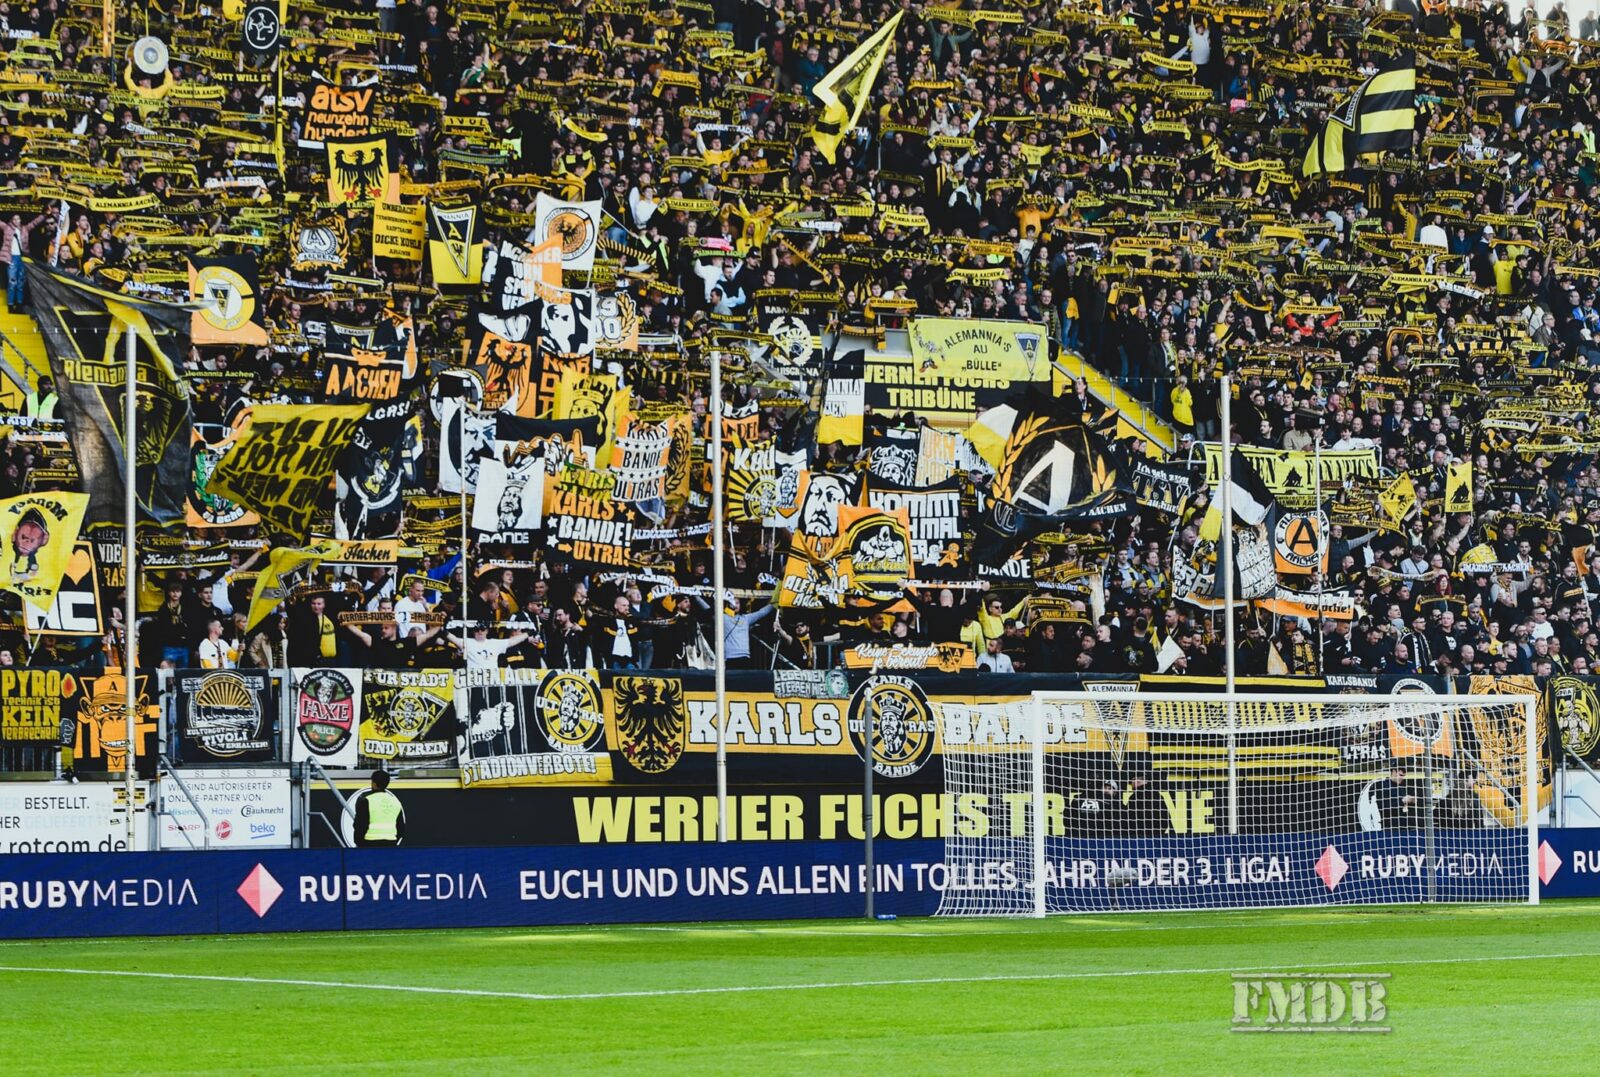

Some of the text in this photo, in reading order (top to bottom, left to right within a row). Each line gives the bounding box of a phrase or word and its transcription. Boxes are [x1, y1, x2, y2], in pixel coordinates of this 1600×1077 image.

[236, 73, 259, 82] WILL
[311, 85, 373, 112] atsv
[308, 110, 369, 126] neunzehn
[1069, 105, 1112, 118] ALEMANNIA
[304, 122, 369, 141] hundert
[1129, 188, 1169, 197] ALEMANNIA
[95, 201, 133, 209] ALEMANNIA
[448, 222, 462, 239] A
[980, 270, 999, 278] AACHEN
[973, 344, 988, 354] AU
[63, 359, 148, 383] Alemana
[225, 370, 255, 379] Aachen
[326, 364, 401, 400] AACHEN
[887, 385, 977, 411] TRIBÜNE
[623, 450, 662, 470] BANDE
[1306, 456, 1375, 486] FANATICS
[612, 477, 659, 499] ULTRAS
[550, 490, 616, 520] KARLS
[870, 491, 961, 517] KOMMT
[1088, 503, 1127, 517] AACHEN
[558, 515, 632, 547] BANDE!
[1290, 518, 1319, 552] A
[343, 543, 391, 561] Aachen
[1, 670, 60, 697] PYRO
[401, 673, 449, 688] STADT
[454, 667, 539, 689] GEGEN ALLE
[866, 674, 914, 691] KARLS
[1500, 684, 1538, 695] ALEMANN
[2, 705, 60, 727] KEIN
[301, 700, 350, 722] FAXE
[312, 725, 336, 736] POLICE
[687, 701, 1088, 746] KARLS BANDE
[202, 731, 249, 746] TIVOLI
[364, 740, 449, 758] UND VEREIN
[1342, 744, 1388, 760] LTRAS
[462, 753, 597, 786] STADIONVERBOTE!
[874, 761, 920, 778] BANDE
[187, 783, 206, 791] SIND
[209, 782, 272, 791] AUTORISIERTER
[25, 796, 90, 810] BESTELLT.
[168, 794, 240, 803] ONLNE-PARTNER
[212, 807, 233, 815] Haier
[241, 805, 284, 817] Bauknecht
[573, 790, 1215, 843] WERNER FUCHS TRNE
[250, 823, 276, 833] beko
[1361, 852, 1502, 879] RUBYMEDIA
[1573, 850, 1600, 873] RU
[520, 869, 603, 900] EUCH
[612, 868, 678, 898] UND
[686, 867, 748, 896] UNS
[756, 865, 850, 895] ALLEN
[859, 863, 904, 893] EIN
[912, 862, 1017, 891] TOLLES
[1136, 859, 1190, 886] DER
[1197, 858, 1219, 884] 3.
[1226, 856, 1290, 884] LIGA!
[1, 879, 199, 909] RUBYMEDIA
[300, 873, 488, 902] RUBYMEDIA
